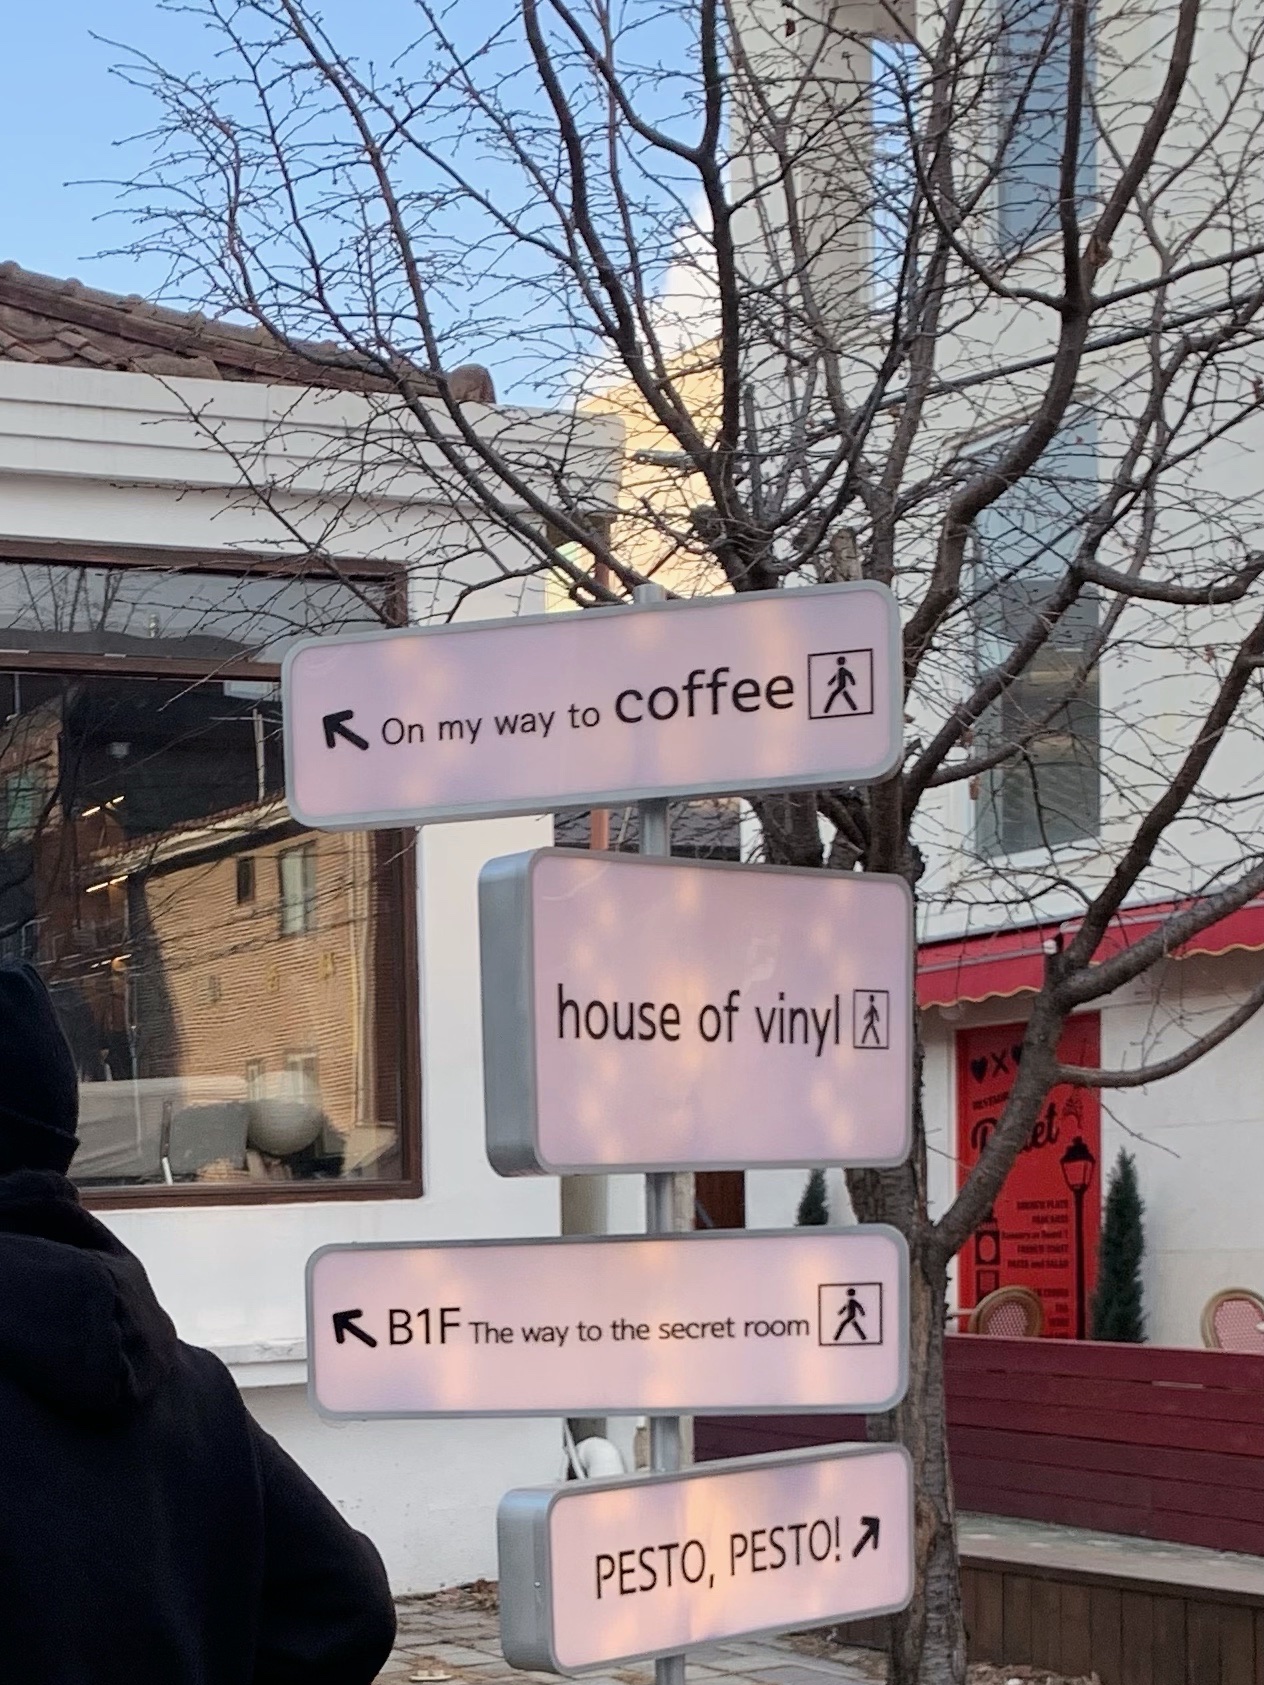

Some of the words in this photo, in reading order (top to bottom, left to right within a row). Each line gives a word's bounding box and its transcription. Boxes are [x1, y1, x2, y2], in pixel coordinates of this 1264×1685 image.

[380, 717, 425, 746] On
[437, 714, 483, 745] my
[493, 710, 556, 739] way
[566, 703, 601, 730] to
[614, 666, 795, 724] coffee
[557, 982, 681, 1042] house
[697, 988, 741, 1044] of
[754, 990, 841, 1058] vinyl
[388, 1306, 462, 1347] B1F
[467, 1319, 515, 1345] The
[520, 1319, 570, 1348] way
[575, 1318, 603, 1343] to
[609, 1315, 651, 1342] the
[658, 1314, 736, 1341] secret
[743, 1315, 811, 1339] room
[594, 1538, 716, 1600] PESTO,
[729, 1514, 842, 1577] PESTO!
